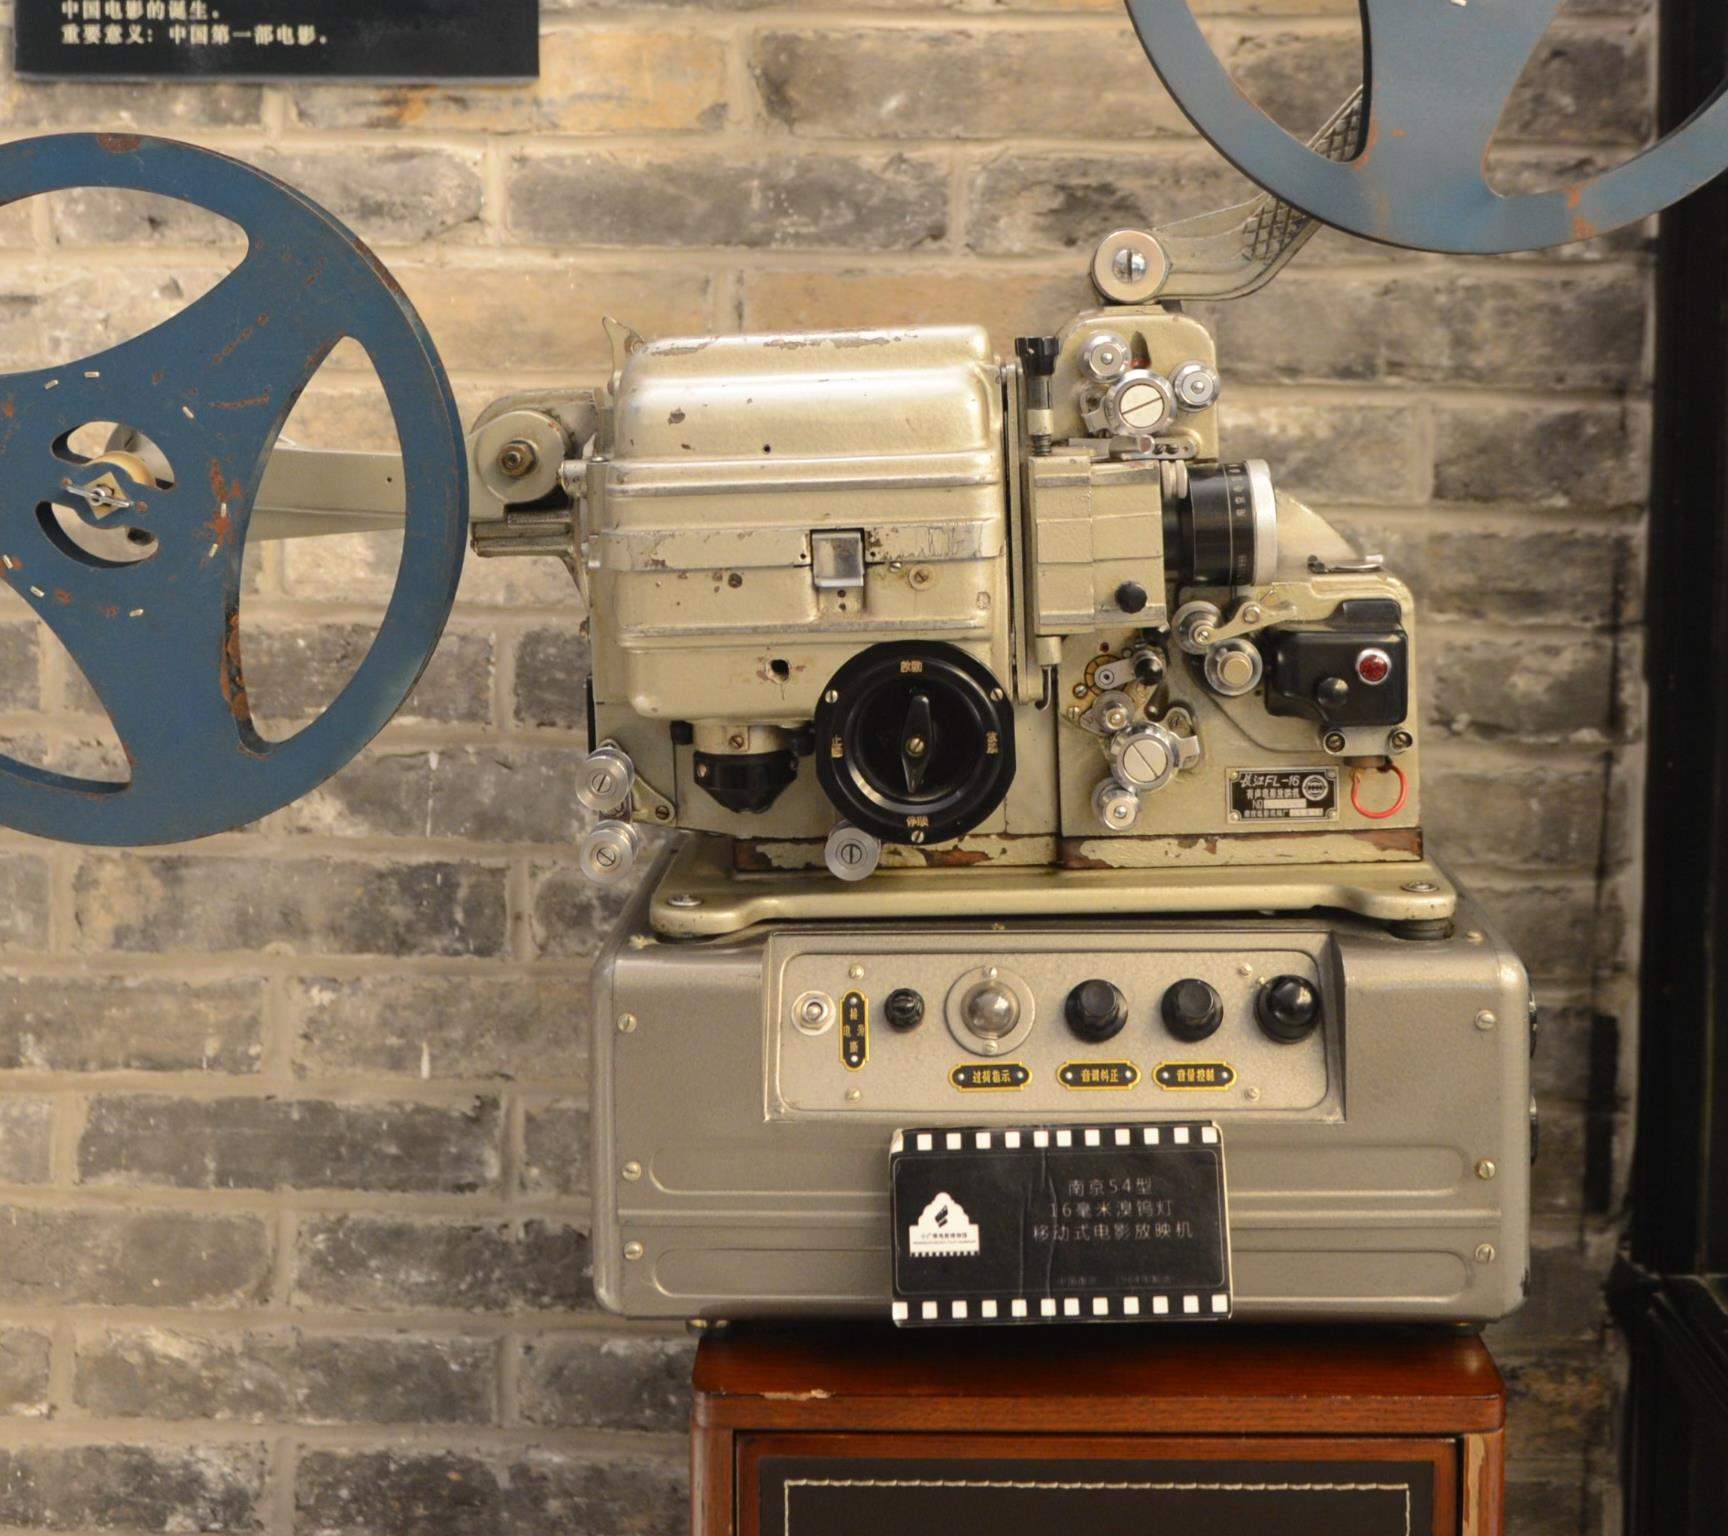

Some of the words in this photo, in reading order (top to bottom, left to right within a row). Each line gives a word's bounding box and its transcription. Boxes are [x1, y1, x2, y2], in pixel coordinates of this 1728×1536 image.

[1032, 1221, 1194, 1241] 移动式电影放映机
